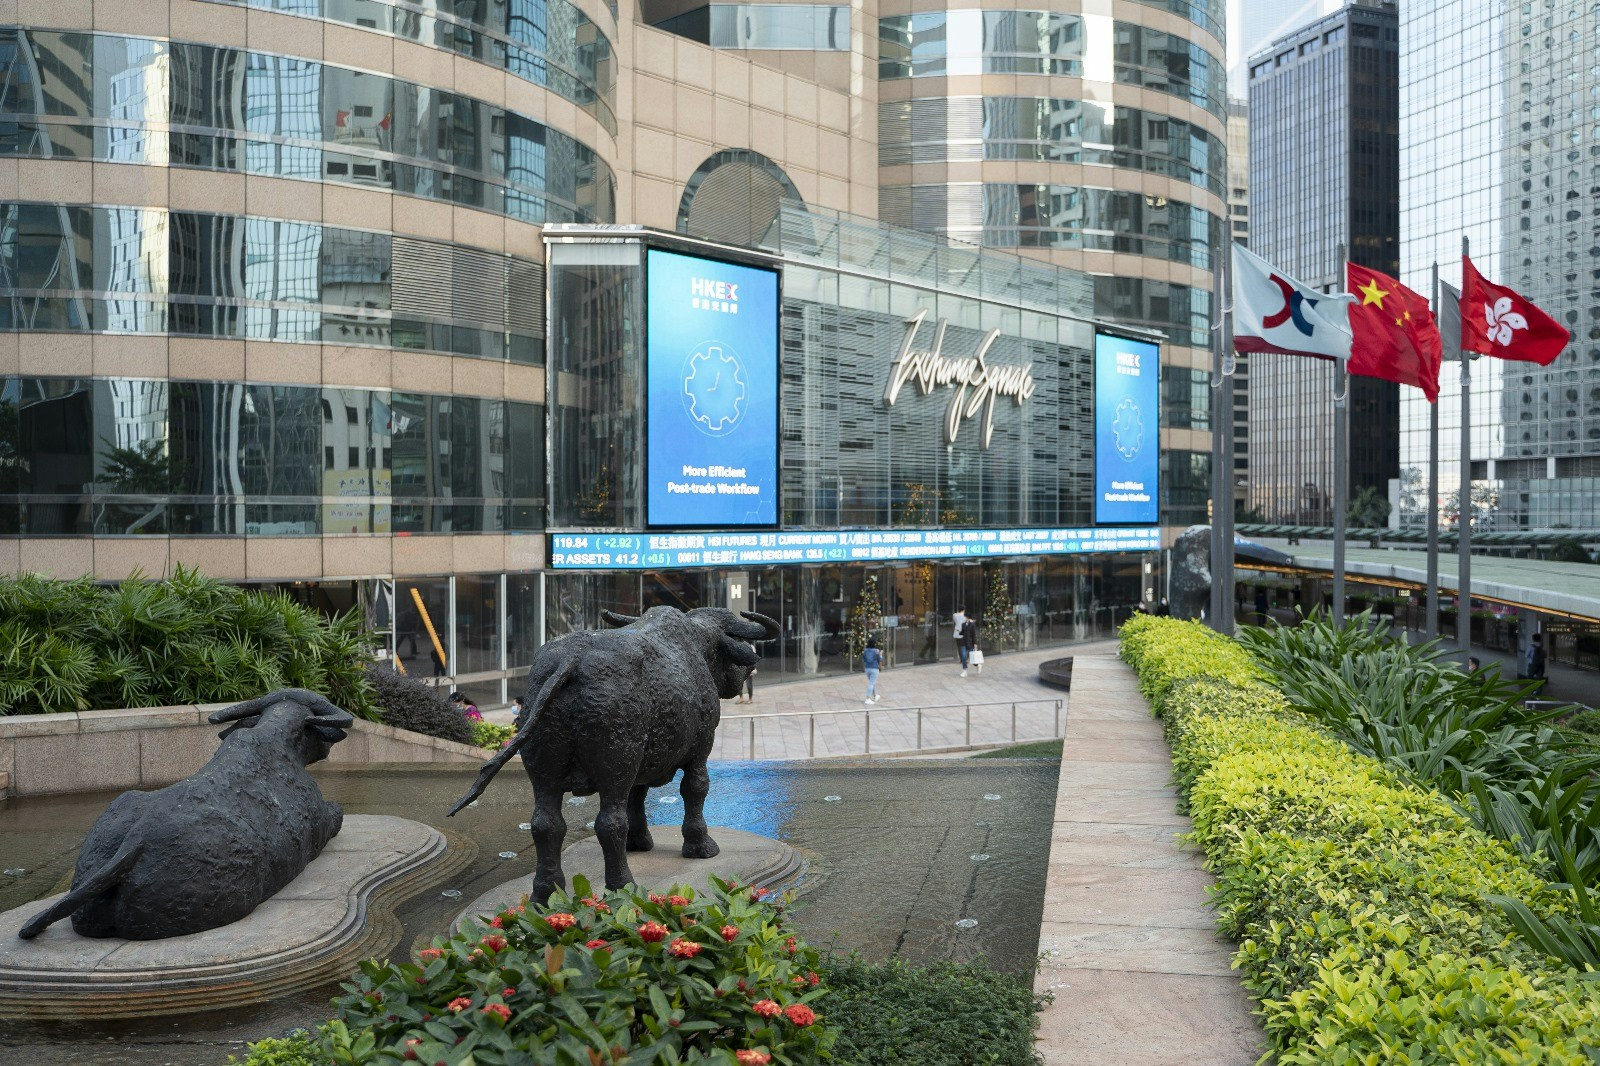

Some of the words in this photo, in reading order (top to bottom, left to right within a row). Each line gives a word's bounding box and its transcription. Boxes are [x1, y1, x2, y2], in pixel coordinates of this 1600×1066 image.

[691, 277, 738, 301] HKEX
[683, 465, 707, 477] More
[708, 465, 746, 478] Efficient
[667, 482, 716, 494] Post-trade
[717, 482, 760, 495] Workflow
[554, 537, 588, 548] 119.84
[722, 535, 757, 546] FUTURES
[566, 553, 611, 565] ASSETS
[615, 553, 639, 564] 41.2
